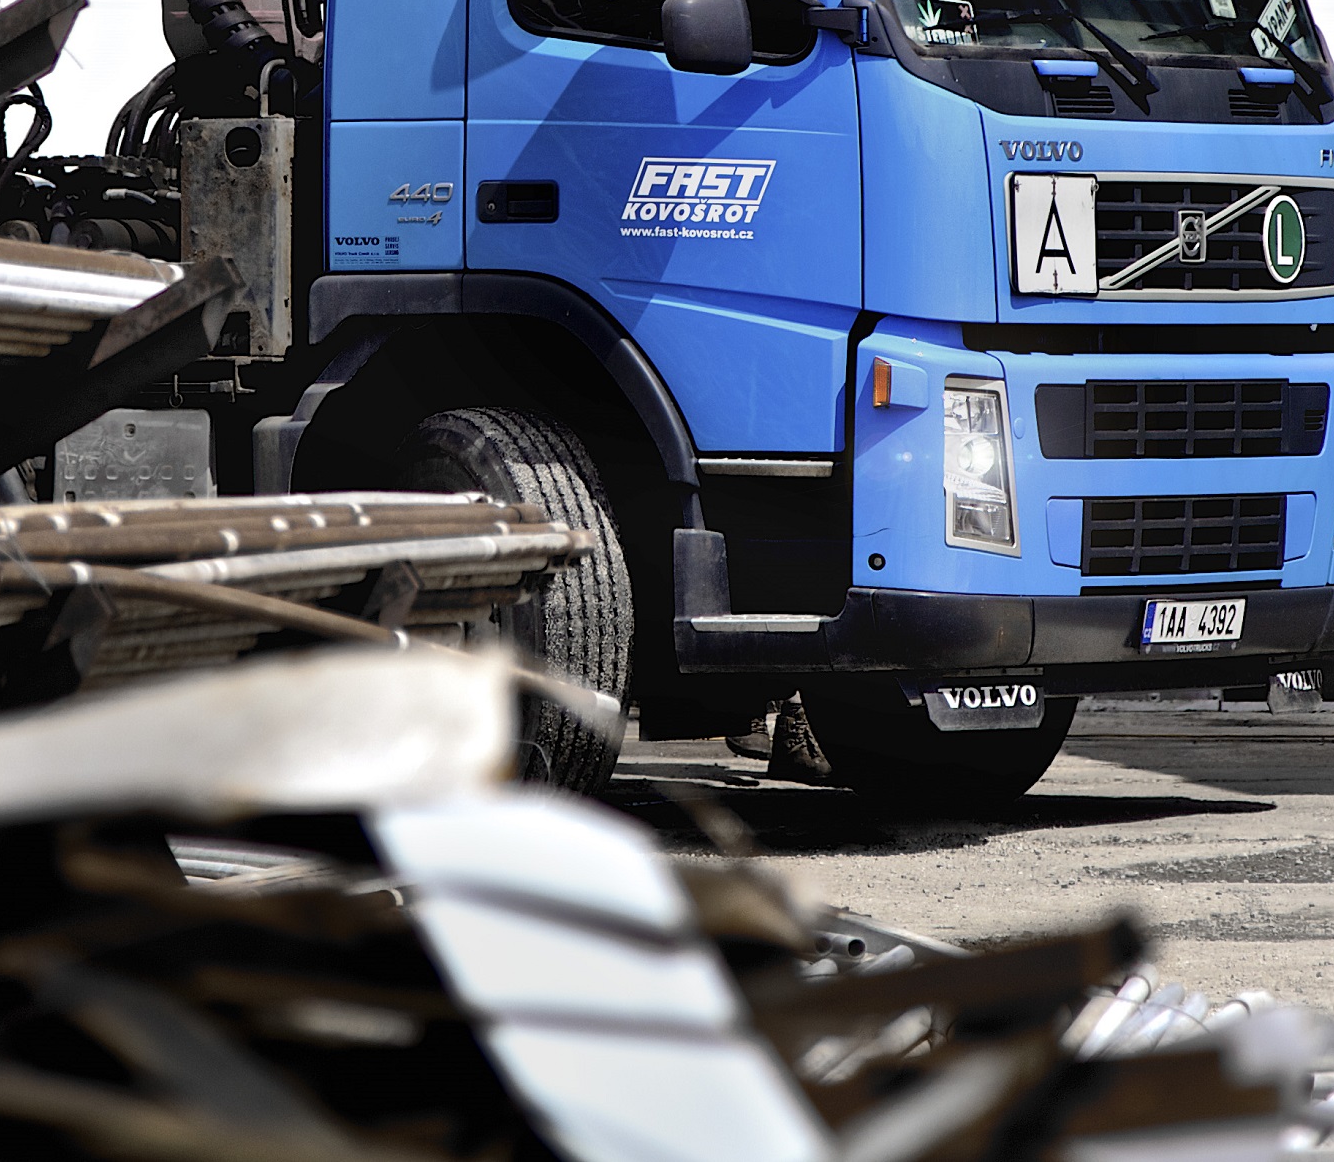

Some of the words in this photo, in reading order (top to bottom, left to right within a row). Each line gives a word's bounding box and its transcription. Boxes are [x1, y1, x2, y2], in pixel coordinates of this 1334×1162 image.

[999, 140, 1083, 162] VOLVO
[389, 182, 453, 202] 440
[637, 165, 767, 198] FAST
[621, 199, 760, 223] KOVOŠROT
[335, 237, 380, 246] VOLVO
[620, 226, 754, 239] www.fast-kovosrot.cz
[1035, 196, 1076, 274] A
[1277, 213, 1294, 266] L
[1160, 607, 1187, 637] 1AA
[1198, 604, 1236, 636] 4392
[1276, 669, 1323, 690] VOLVO
[938, 684, 1037, 709] VOLVO
